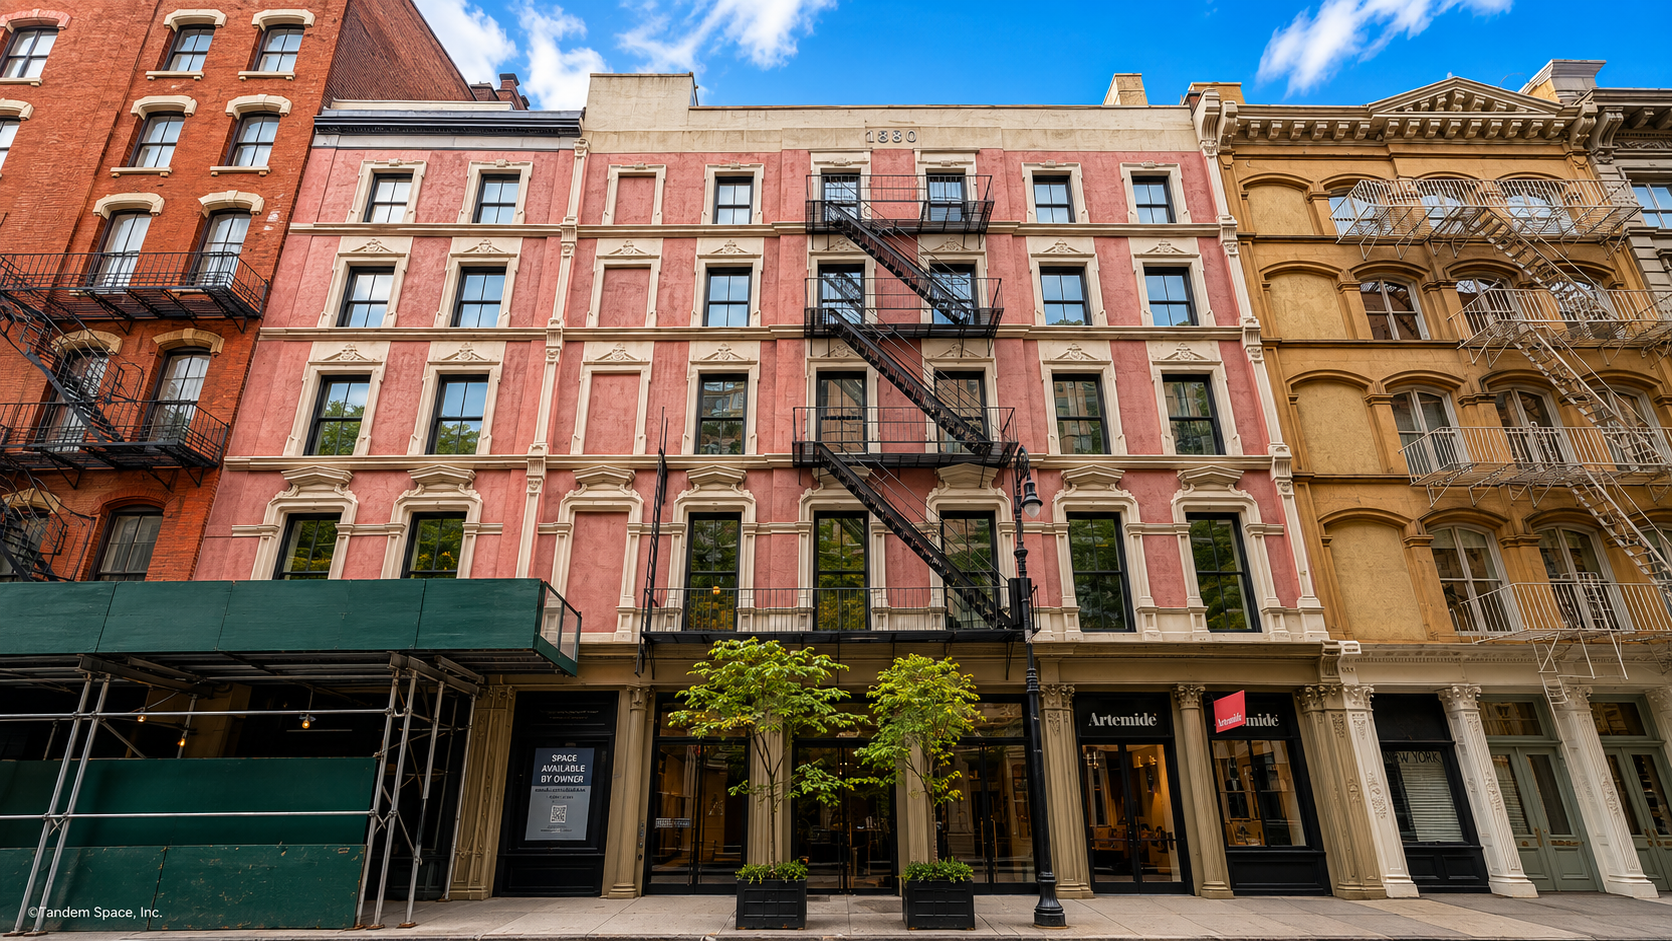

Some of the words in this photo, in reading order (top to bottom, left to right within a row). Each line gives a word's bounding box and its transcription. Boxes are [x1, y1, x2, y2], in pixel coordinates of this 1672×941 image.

[865, 129, 917, 143] 1880
[551, 754, 578, 763] SPACE
[1410, 751, 1443, 765] YORK
[540, 764, 586, 773] AVAILABLE
[540, 774, 553, 783] BY
[553, 774, 584, 783] OWNER
